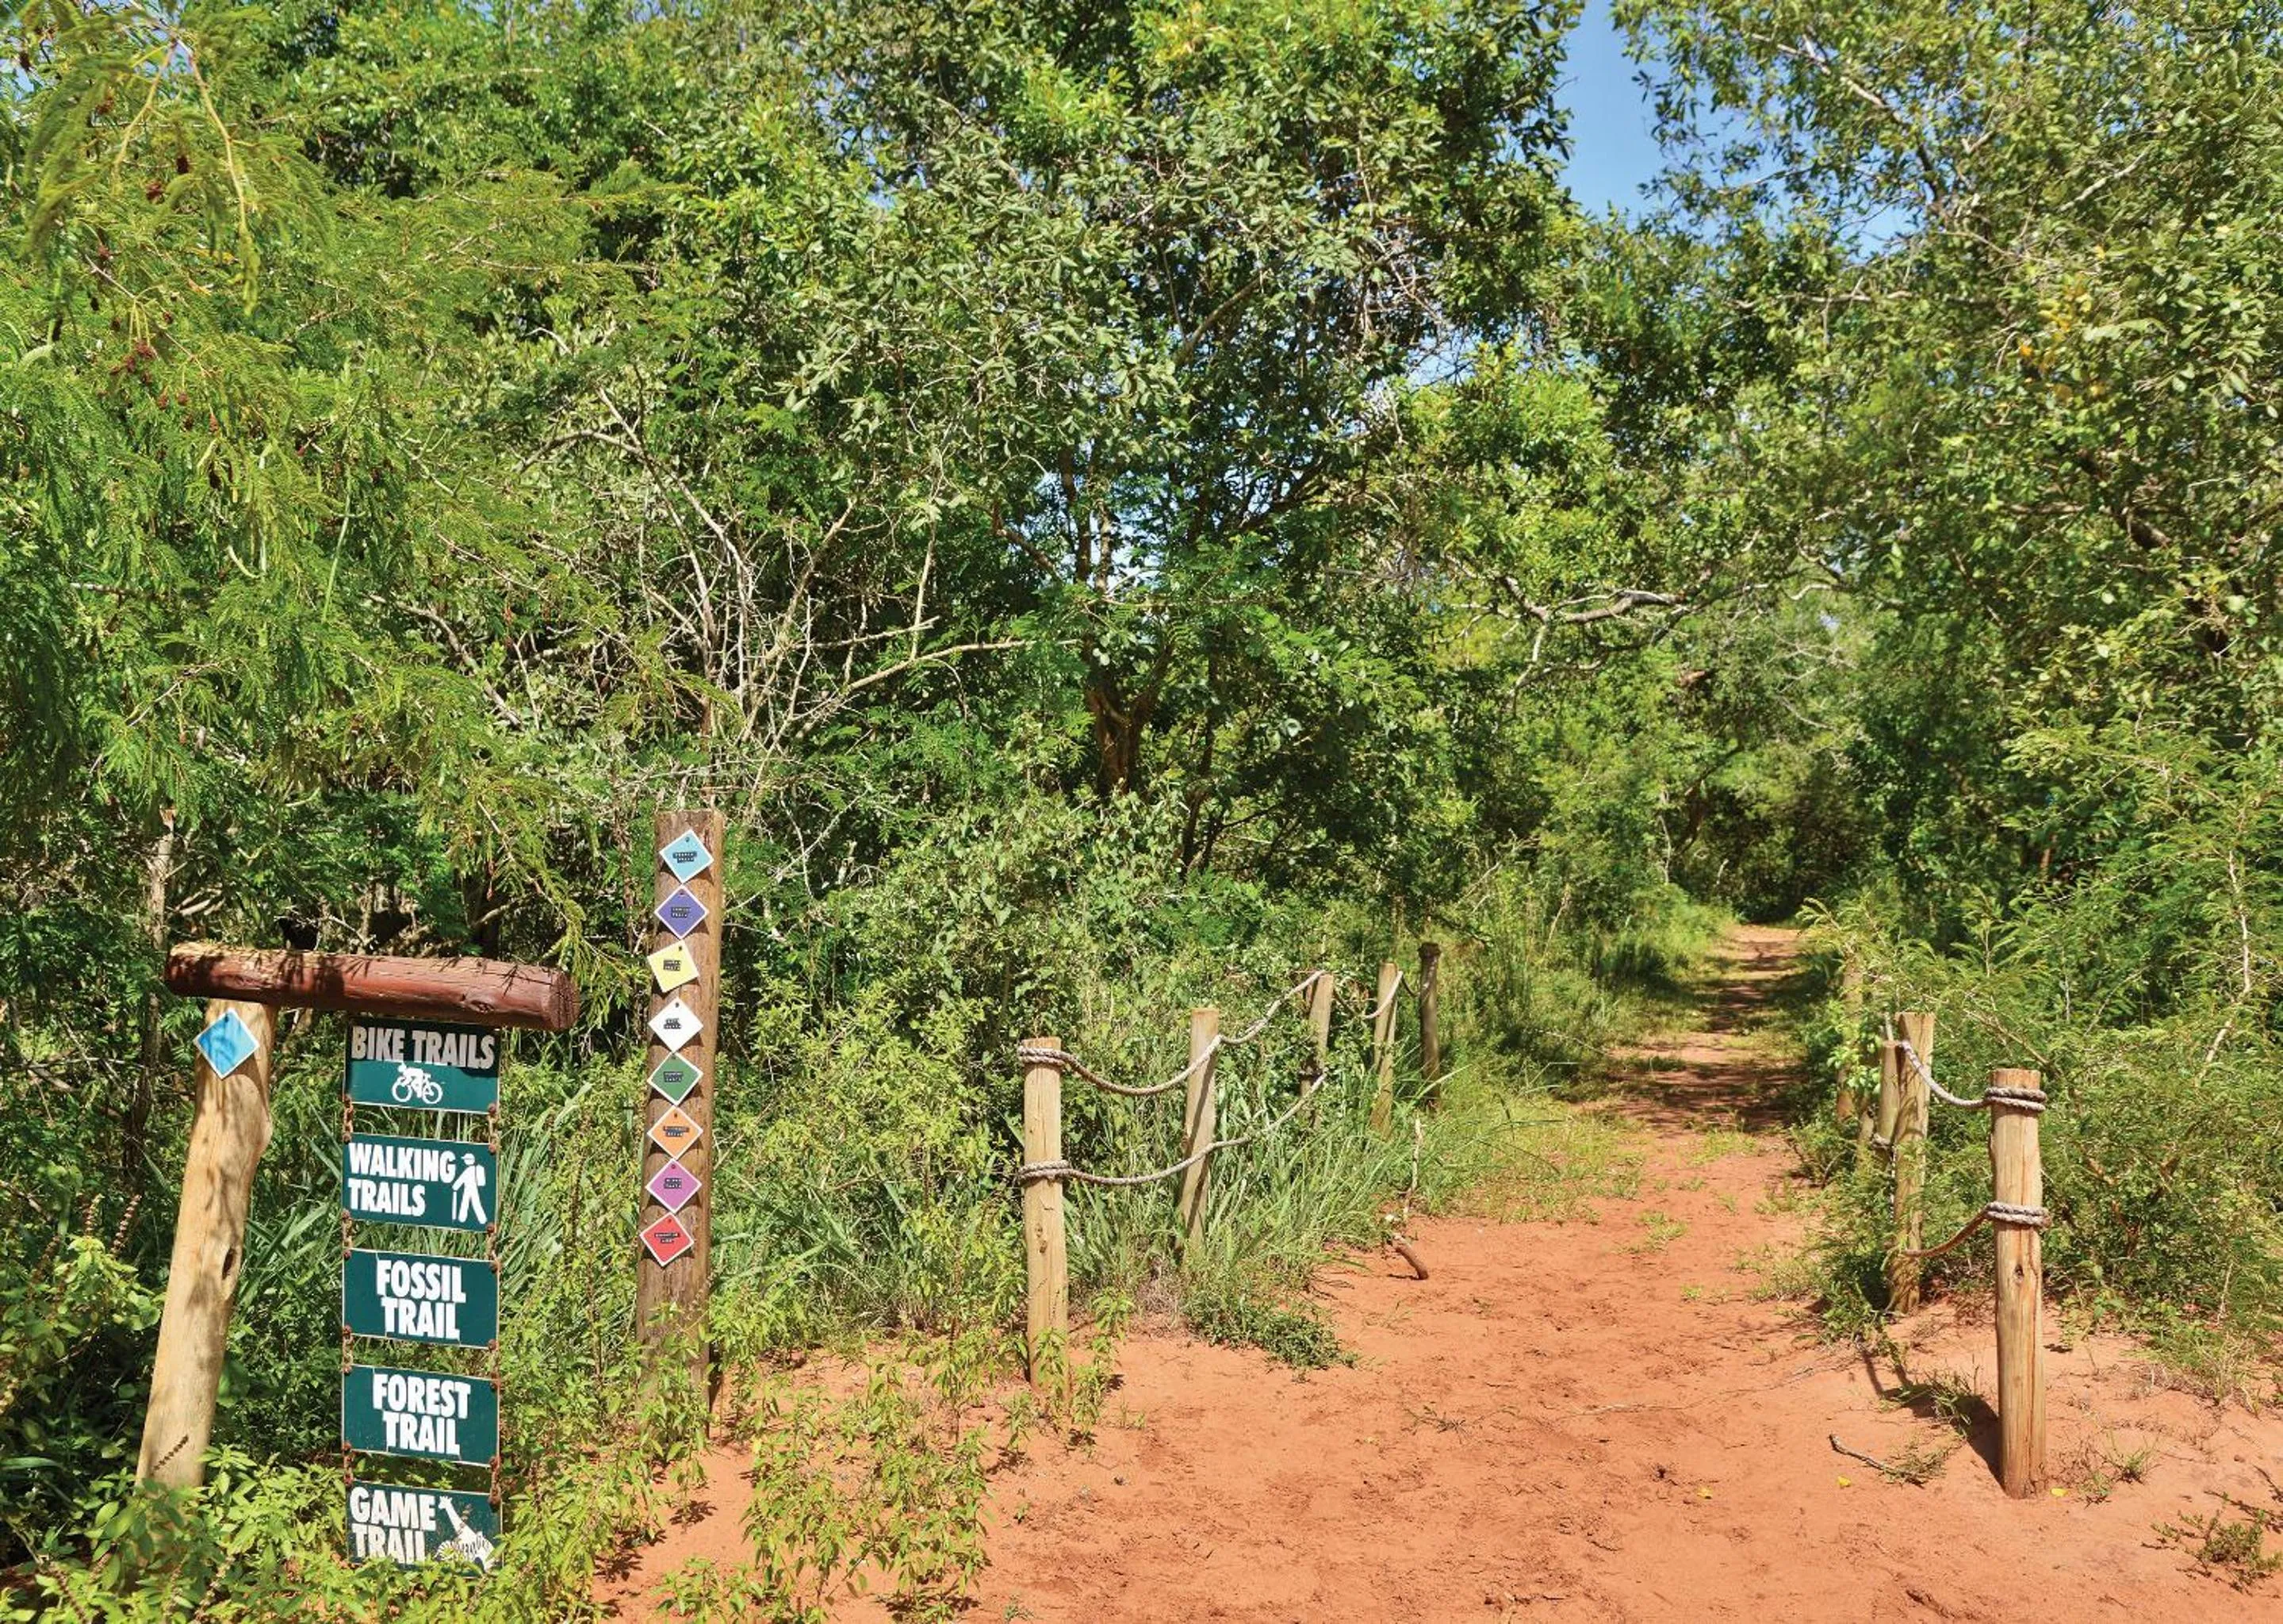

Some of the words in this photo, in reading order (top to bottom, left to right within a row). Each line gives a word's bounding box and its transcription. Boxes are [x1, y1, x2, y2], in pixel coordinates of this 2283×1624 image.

[350, 1026, 405, 1063] BIKE
[412, 1030, 496, 1070] TRAILS
[348, 1143, 456, 1183] WALKING
[348, 1178, 426, 1216] TRAILS
[377, 1259, 466, 1304] FOSSIL
[381, 1297, 460, 1339] TRAIL
[373, 1373, 471, 1419] FOREST
[382, 1411, 460, 1455] TRAIL
[350, 1486, 436, 1531] GAME
